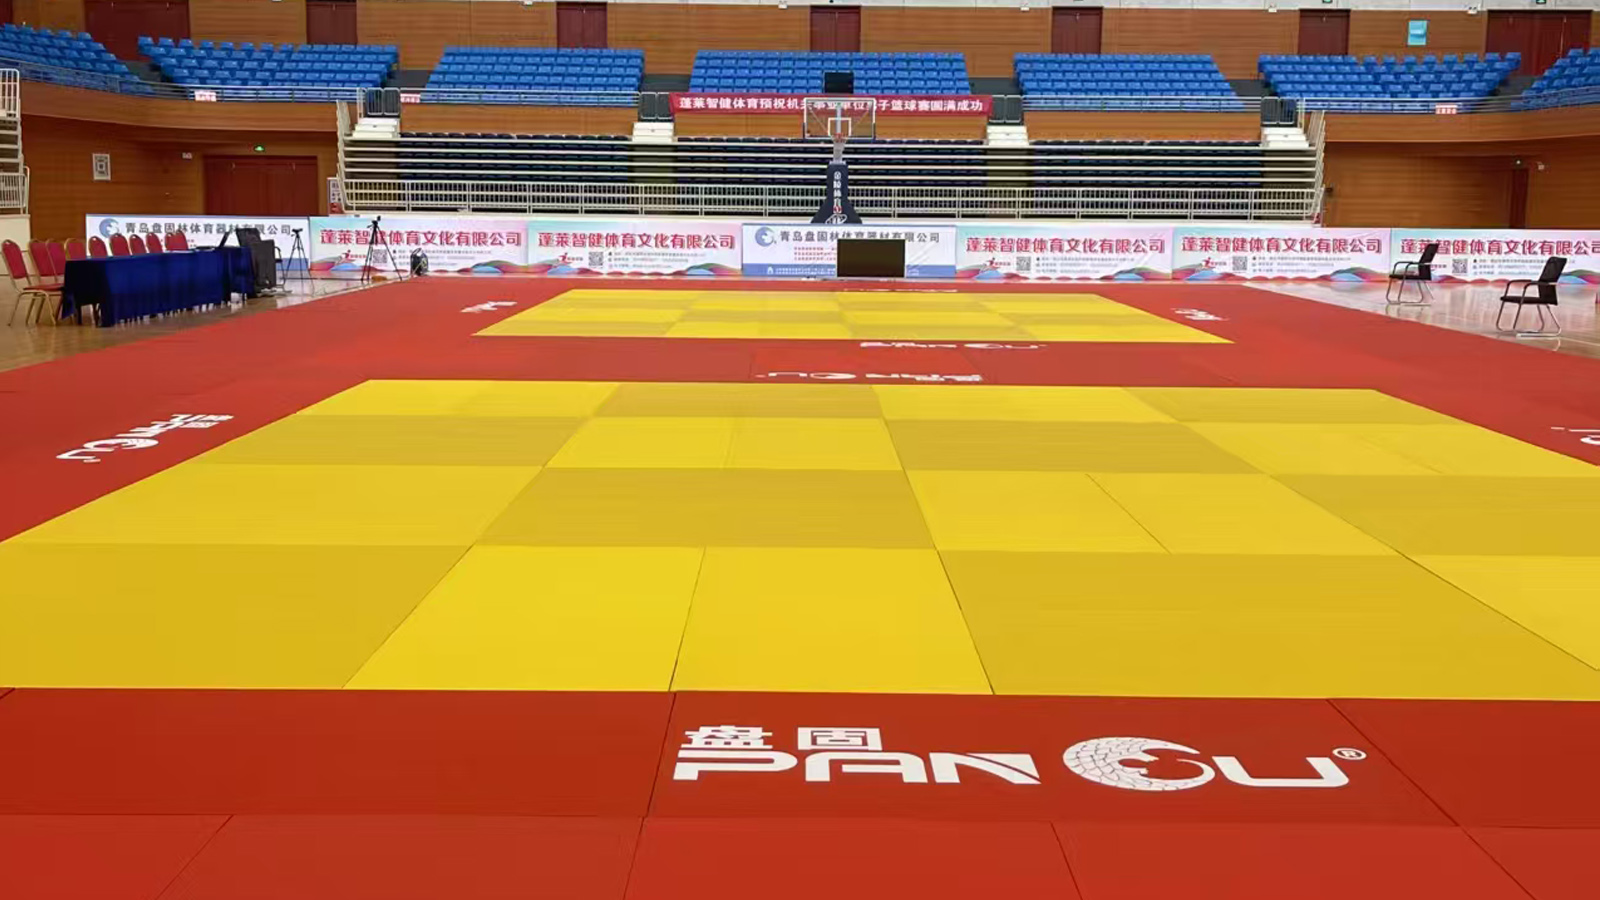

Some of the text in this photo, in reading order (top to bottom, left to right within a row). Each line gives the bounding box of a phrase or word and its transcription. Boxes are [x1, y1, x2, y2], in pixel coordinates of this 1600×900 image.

[679, 97, 983, 111] 蓬莱智健体育预祝机关事业单位子篮球赛圆满成功
[320, 229, 522, 246] 蓬莱智健体育文化有限公司
[538, 232, 735, 249] 蓬莱智健体育文化有限公司
[966, 237, 1165, 254] 蓬莱智健体育文化有限公司
[1182, 237, 1381, 254] 蓬莱智健体育文化有限公司
[684, 725, 883, 750] 盘固
[673, 749, 1041, 785] PAN
